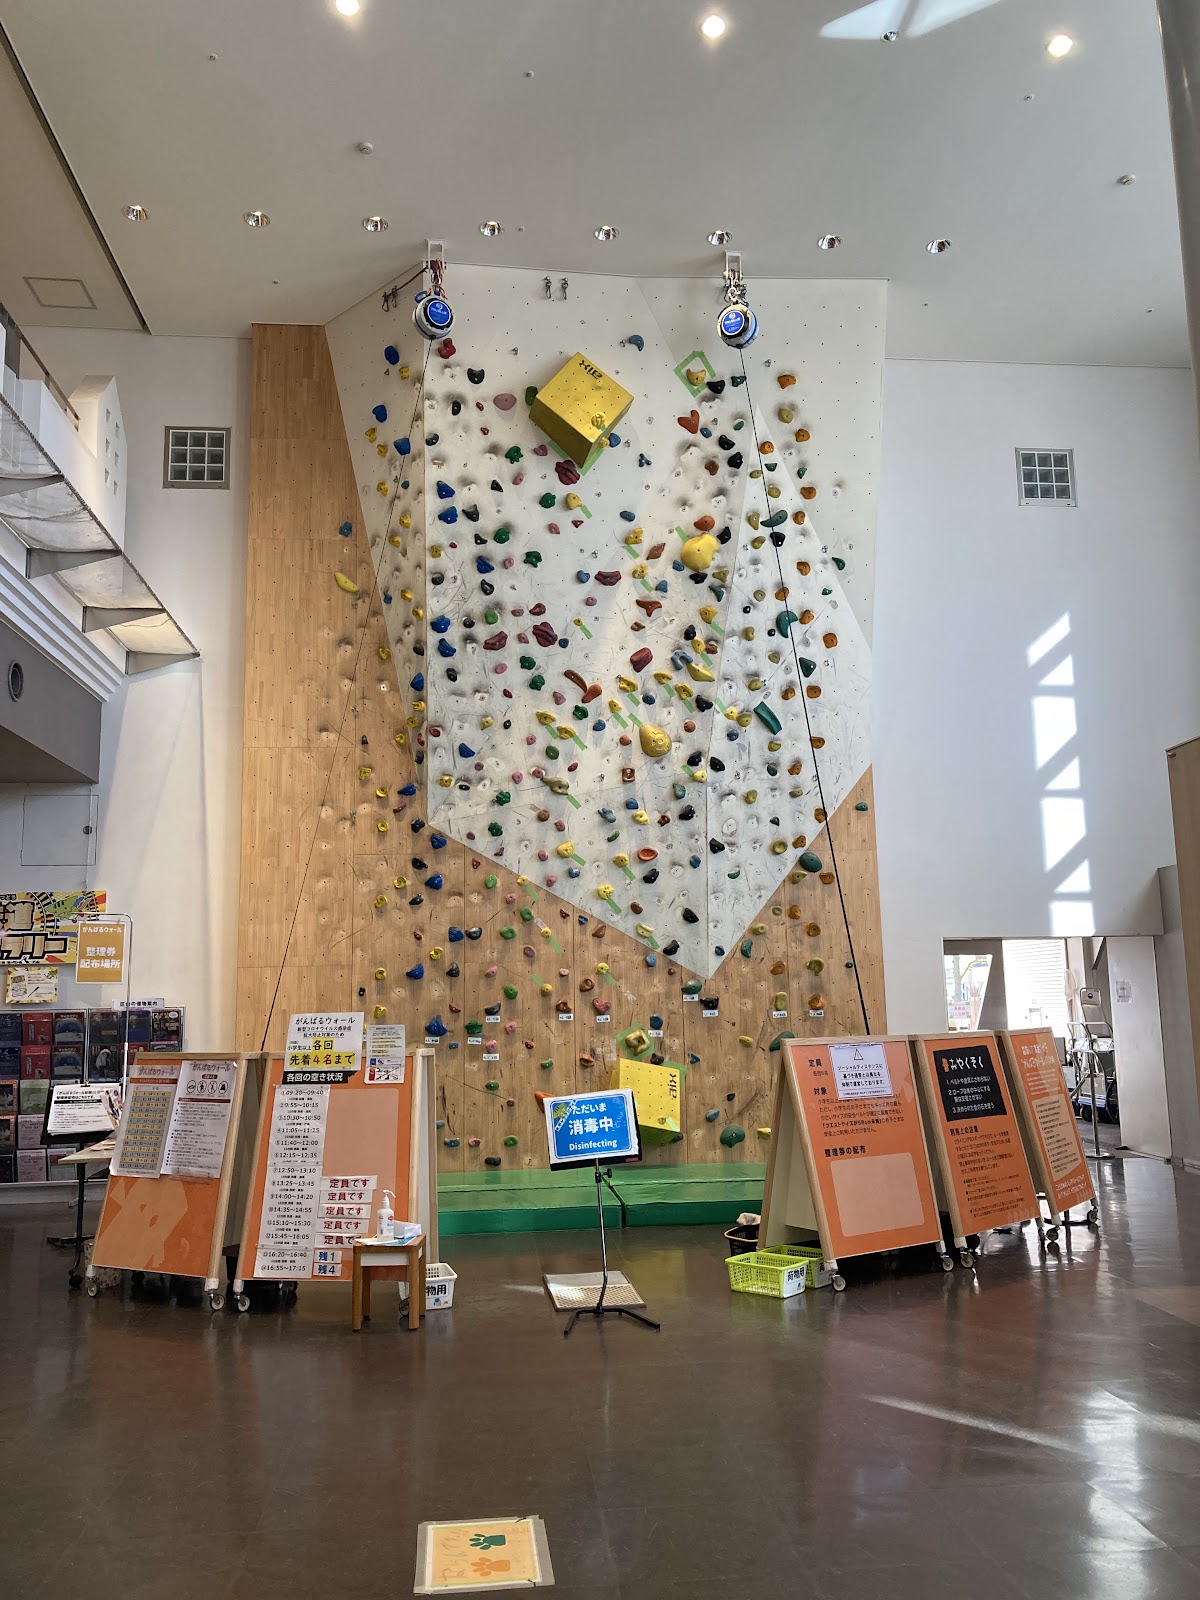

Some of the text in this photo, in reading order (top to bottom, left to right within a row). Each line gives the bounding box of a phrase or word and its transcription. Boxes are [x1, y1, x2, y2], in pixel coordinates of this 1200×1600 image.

[86, 946, 116, 957] 整理券
[80, 959, 121, 969] 配布場所
[295, 1016, 356, 1025] がんばるウォール
[312, 1040, 334, 1051] 各回
[192, 1062, 231, 1073] がんばるウォール
[808, 1059, 822, 1067] 定員
[949, 1056, 984, 1071] おやくそく
[138, 1067, 175, 1076] がんばるウォール
[286, 1073, 343, 1082] 各回の空き状況
[813, 1088, 828, 1096] 対象
[572, 1102, 607, 1115] ただいま
[568, 1116, 614, 1136] 消毒中
[569, 1139, 618, 1151] Disinfecting
[824, 1146, 866, 1158] 整理券の配布
[330, 1179, 370, 1188] 定員です
[328, 1192, 365, 1201] 定員です
[326, 1206, 364, 1216] 定員です
[324, 1221, 362, 1230] 定員です
[324, 1235, 361, 1245] 定員で
[318, 1251, 335, 1261] 残1
[318, 1265, 336, 1275] 残4
[787, 1266, 805, 1282] 荷物用
